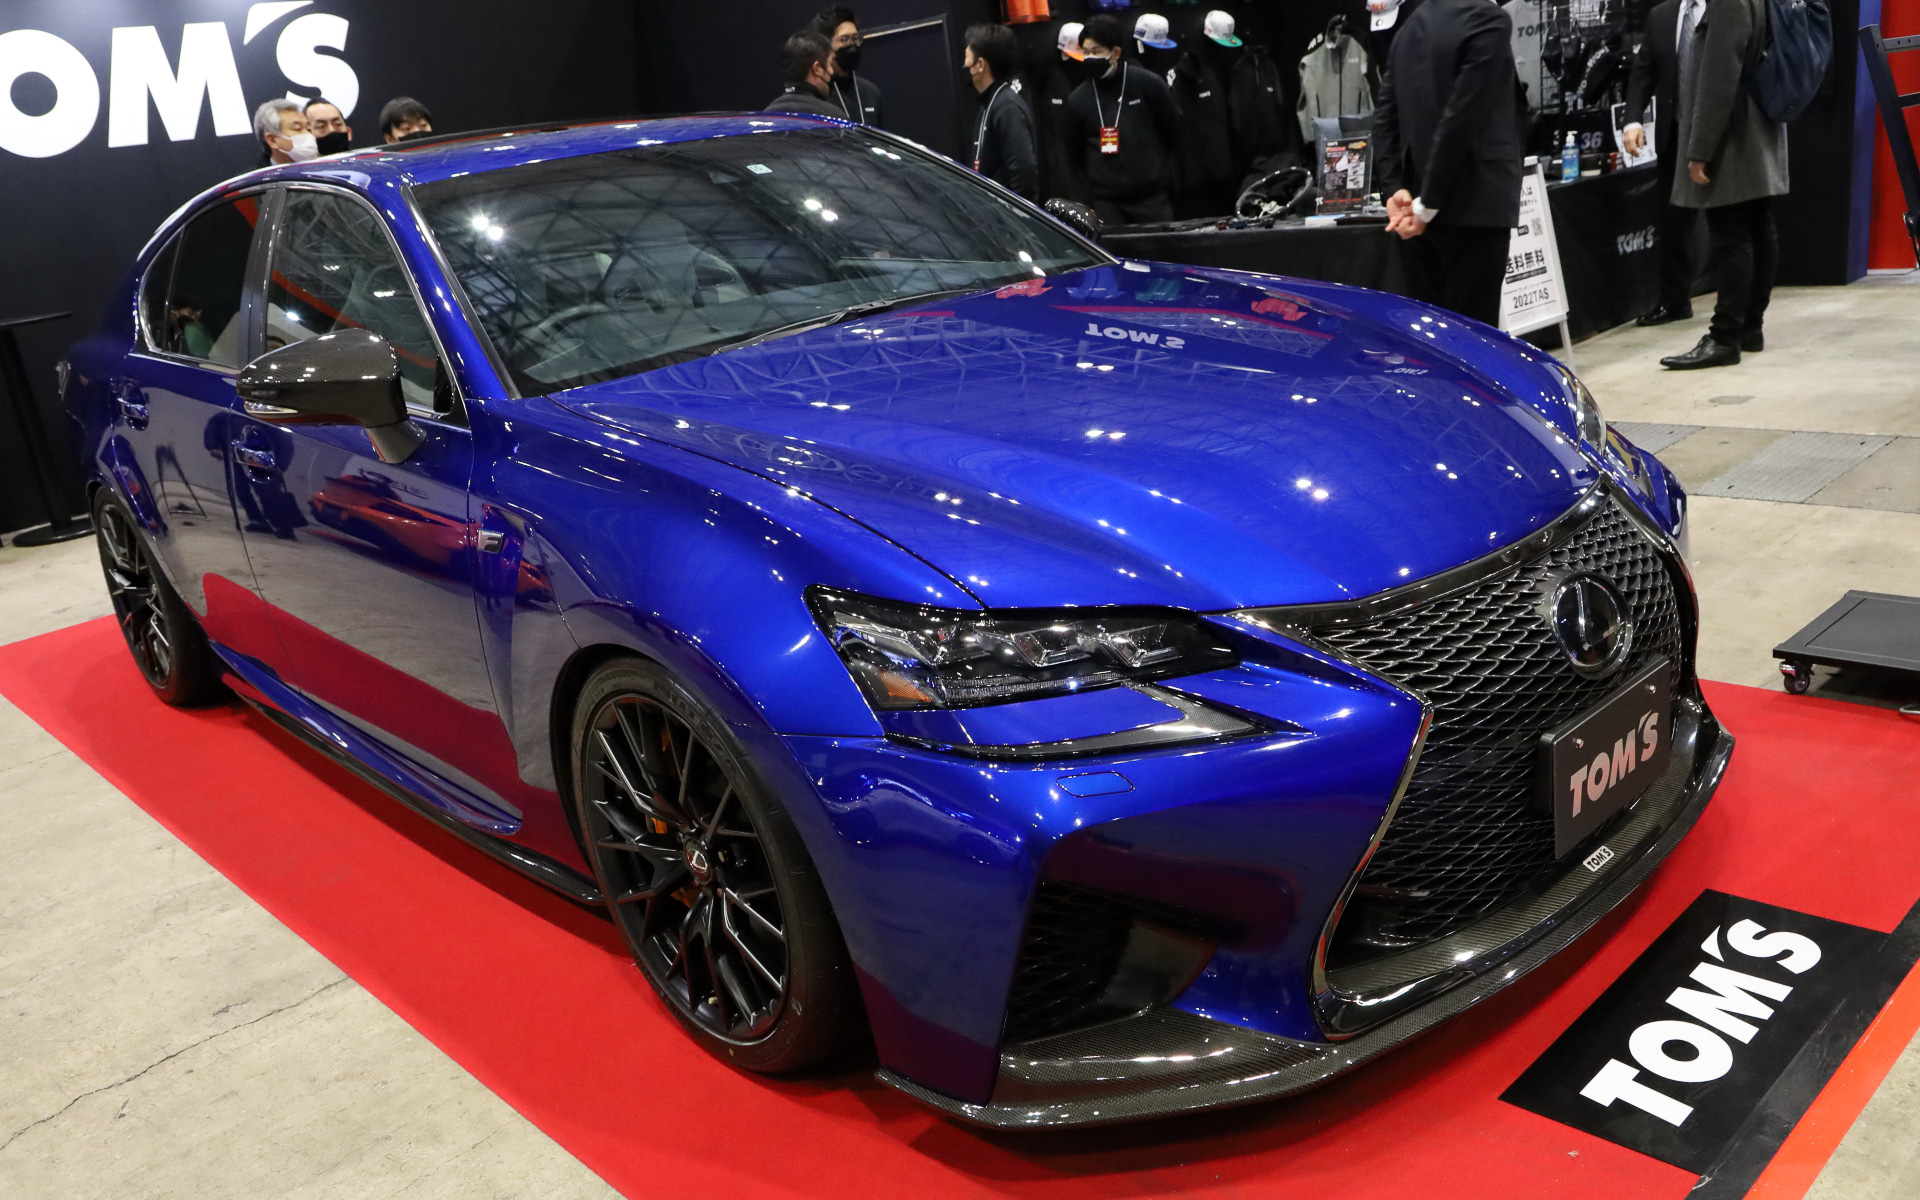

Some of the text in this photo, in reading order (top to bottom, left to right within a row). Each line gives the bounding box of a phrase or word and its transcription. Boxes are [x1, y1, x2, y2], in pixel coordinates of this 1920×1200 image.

[1580, 131, 1603, 149] 36
[1616, 225, 1655, 256] TOM'S
[1506, 249, 1544, 274] 送料無料
[1513, 287, 1549, 309] 2022TAS
[1569, 709, 1659, 818] TOM'S
[1586, 845, 1612, 870] TOM'S
[1578, 918, 1822, 1128] TOM'S
